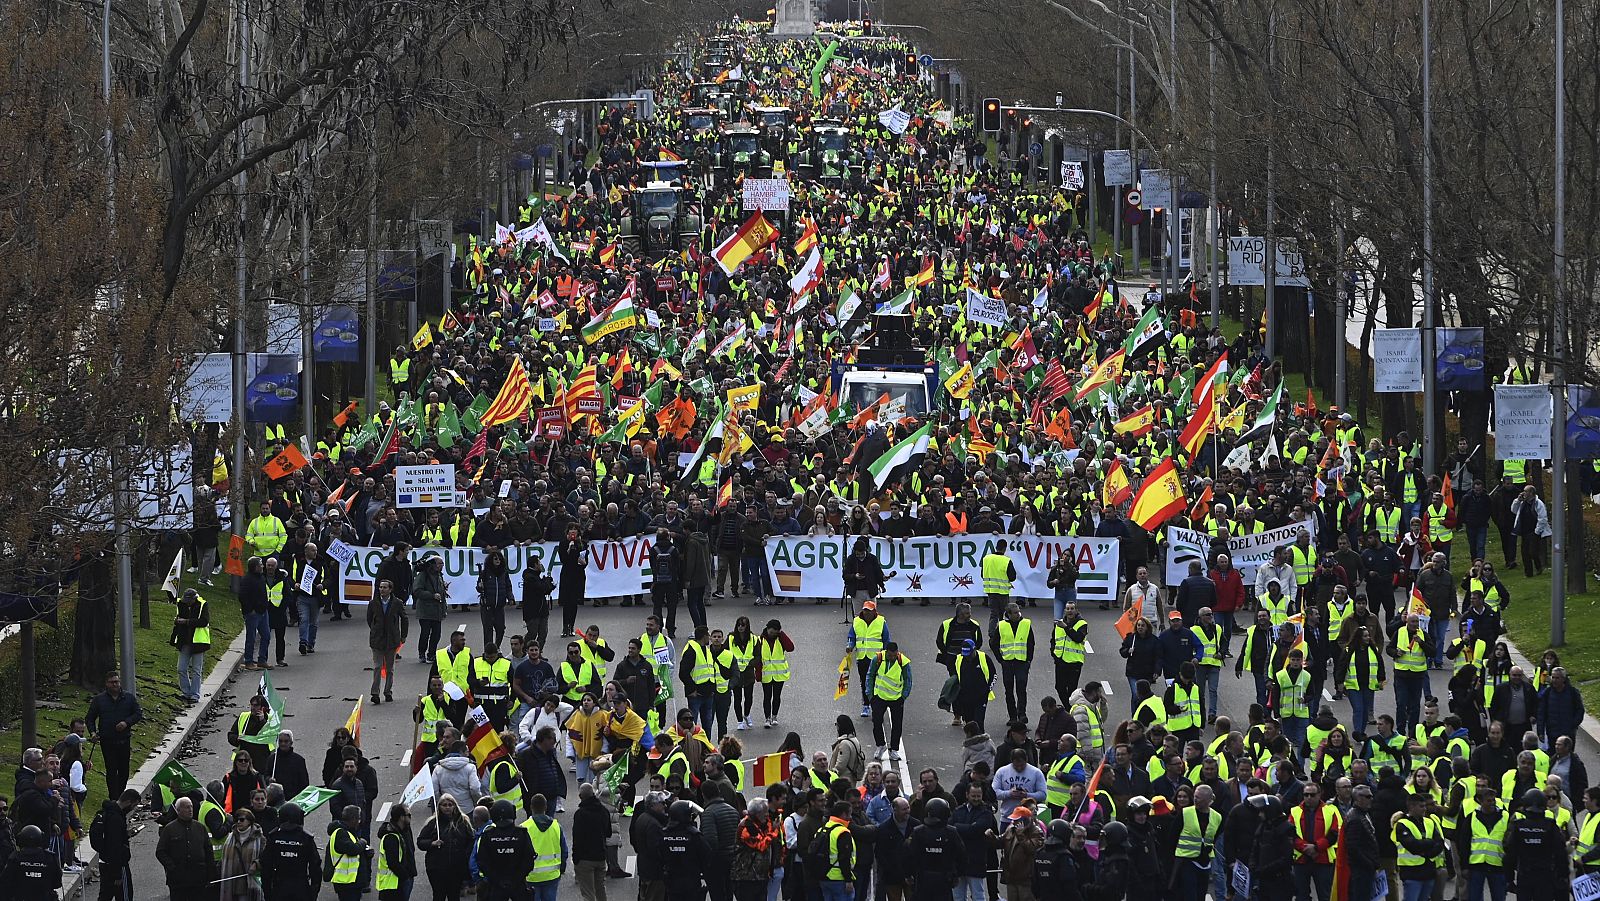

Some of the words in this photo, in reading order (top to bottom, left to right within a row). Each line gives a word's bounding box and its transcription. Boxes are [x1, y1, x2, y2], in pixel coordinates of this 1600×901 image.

[435, 239, 450, 248] RA
[1231, 241, 1263, 252] MAD
[1243, 253, 1263, 263] RID
[1230, 539, 1251, 550] DEL
[472, 712, 487, 723] Bas
[1005, 775, 1031, 784] TOMMY
